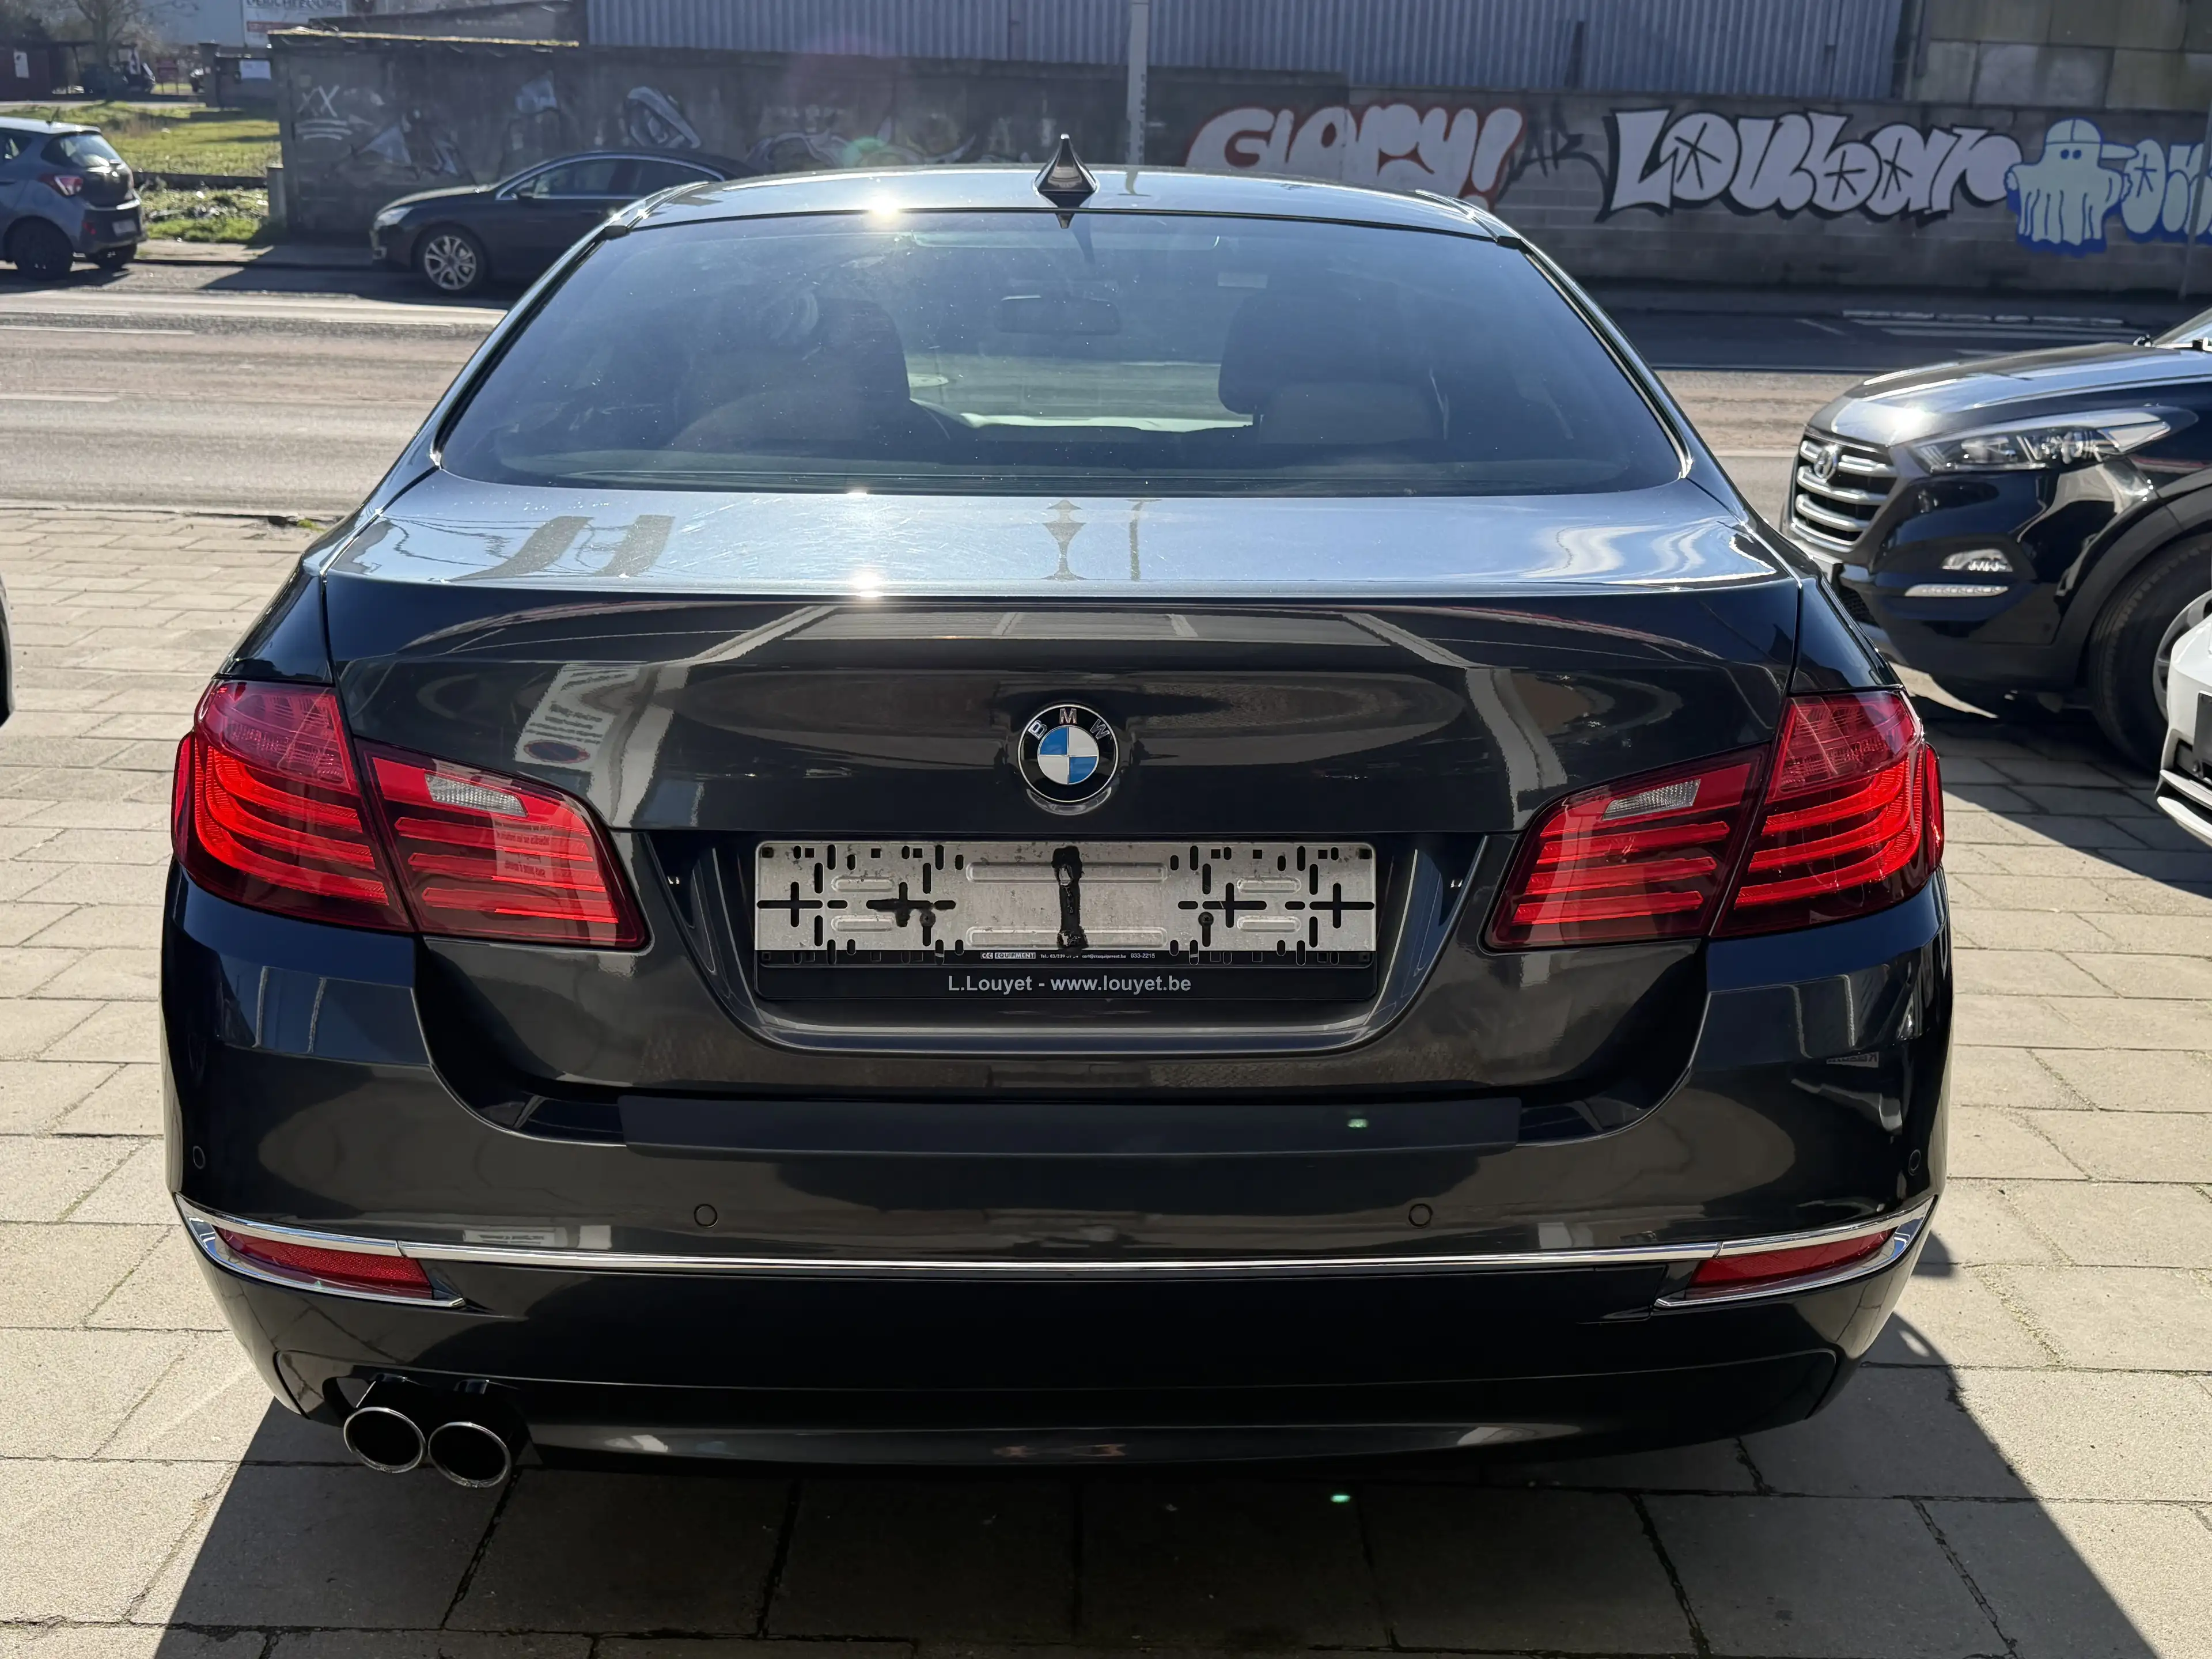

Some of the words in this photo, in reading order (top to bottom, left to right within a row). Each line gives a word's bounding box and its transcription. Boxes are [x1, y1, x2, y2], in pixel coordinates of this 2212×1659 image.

[1028, 708, 1111, 740] BMW
[948, 975, 1033, 995] L.Louyet
[1050, 975, 1192, 995] www.louyet.be
